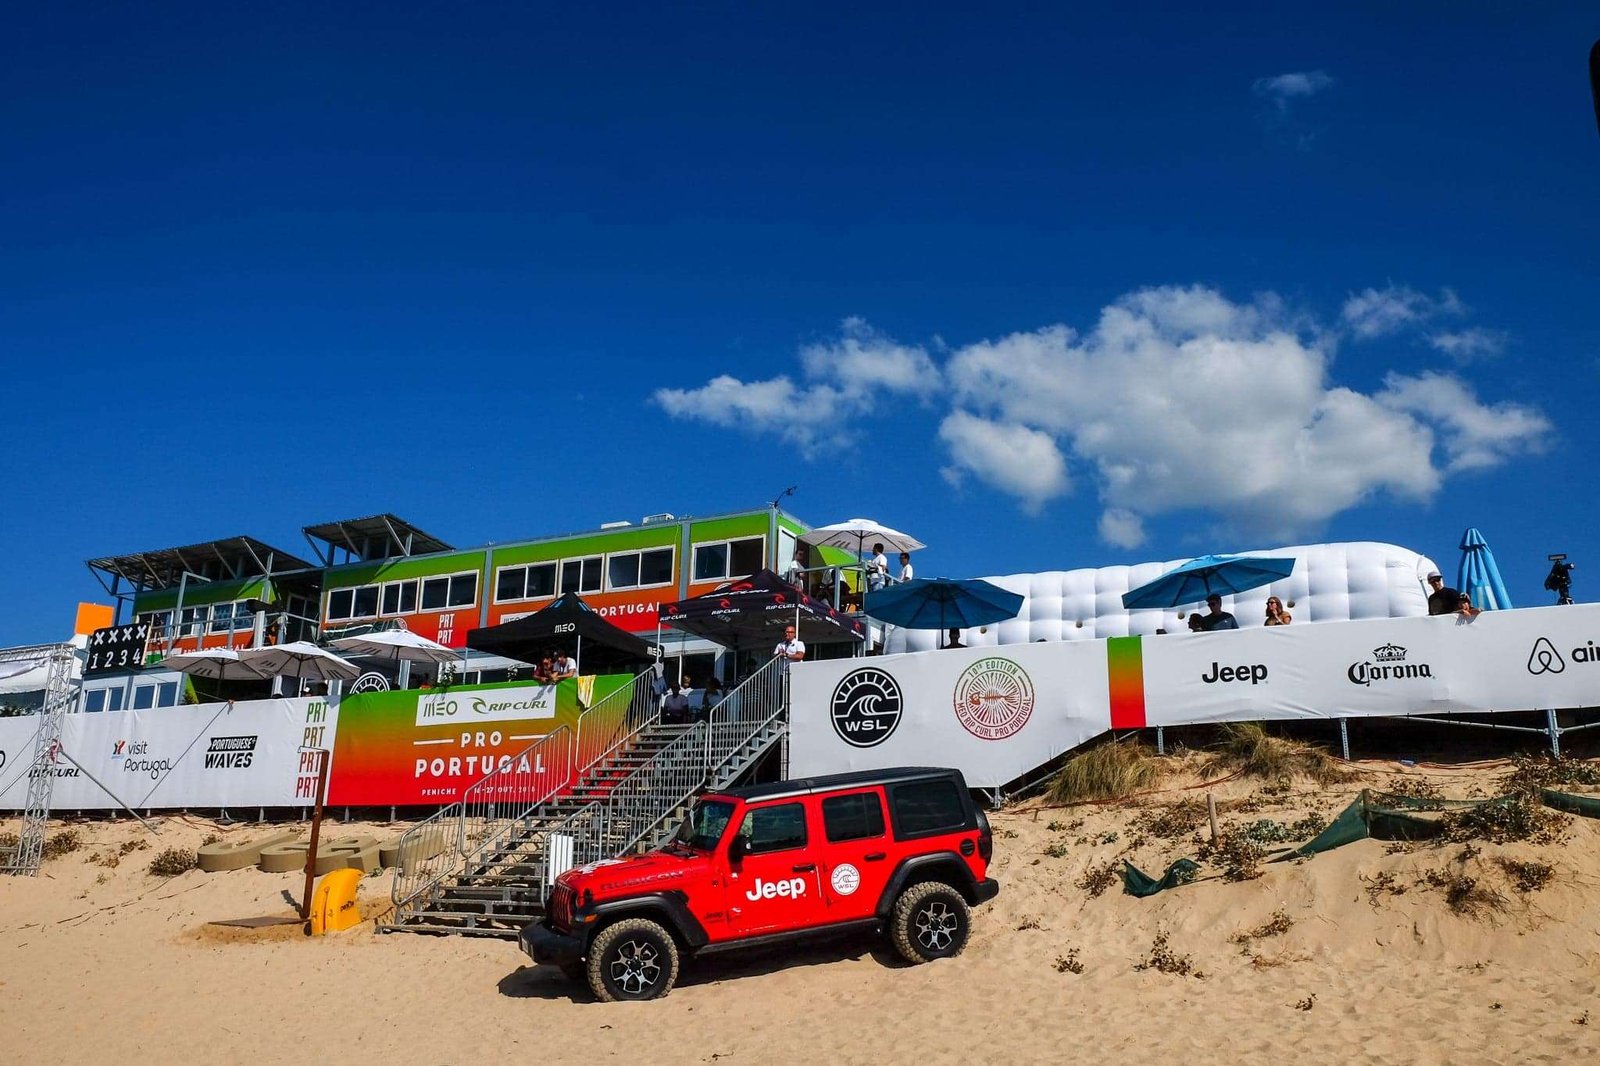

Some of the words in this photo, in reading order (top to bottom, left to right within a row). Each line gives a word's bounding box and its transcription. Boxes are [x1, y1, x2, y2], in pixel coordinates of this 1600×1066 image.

[438, 613, 455, 629] PRT
[554, 622, 576, 633] MEO
[437, 629, 453, 644] PRT
[985, 660, 1019, 675] EDITION
[1201, 661, 1268, 685] Jeep
[1347, 660, 1433, 687] Corona
[305, 701, 329, 723] PRT
[423, 700, 458, 717] MEO
[488, 702, 512, 712] RIP
[513, 700, 548, 710] CURL
[844, 719, 888, 732] WSL
[975, 725, 993, 737] CURL
[994, 726, 1010, 737] PRO
[302, 726, 325, 747] PRT
[460, 730, 502, 748] PRO
[128, 741, 148, 755] visit
[123, 757, 172, 780] Portugal
[205, 752, 254, 769] WAVES
[299, 751, 322, 773] PRT
[414, 754, 546, 778] PORTUGAL
[295, 777, 319, 798] PRT
[421, 788, 457, 796] PENICHE
[745, 877, 806, 901] Jeep
